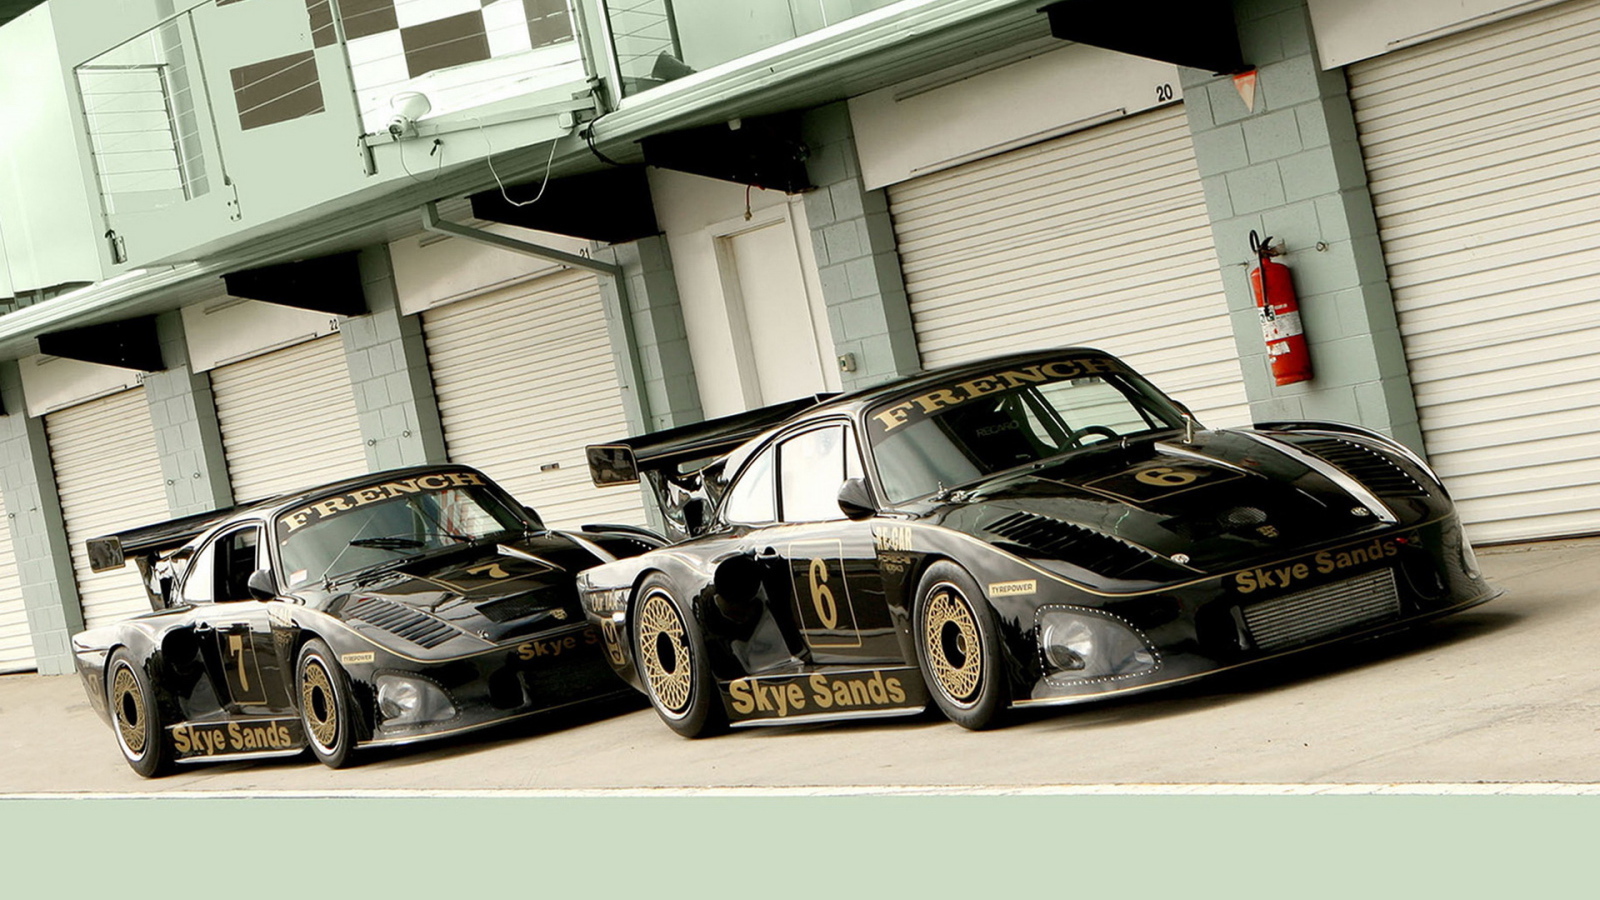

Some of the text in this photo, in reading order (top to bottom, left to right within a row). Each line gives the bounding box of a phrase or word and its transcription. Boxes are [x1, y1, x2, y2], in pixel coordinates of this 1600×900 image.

[1156, 83, 1173, 102] 20
[329, 318, 339, 331] 22
[872, 358, 1120, 432] FRENCH
[1135, 467, 1197, 487] 6
[279, 472, 486, 533] FRENCH
[1235, 539, 1398, 594] Skye Sands
[809, 557, 838, 630] 6
[991, 583, 1033, 594] TYREPOWER
[229, 635, 249, 692] 7
[517, 636, 576, 660] Skye
[729, 670, 906, 717] Skye Sands
[172, 720, 291, 756] Skye Sands
